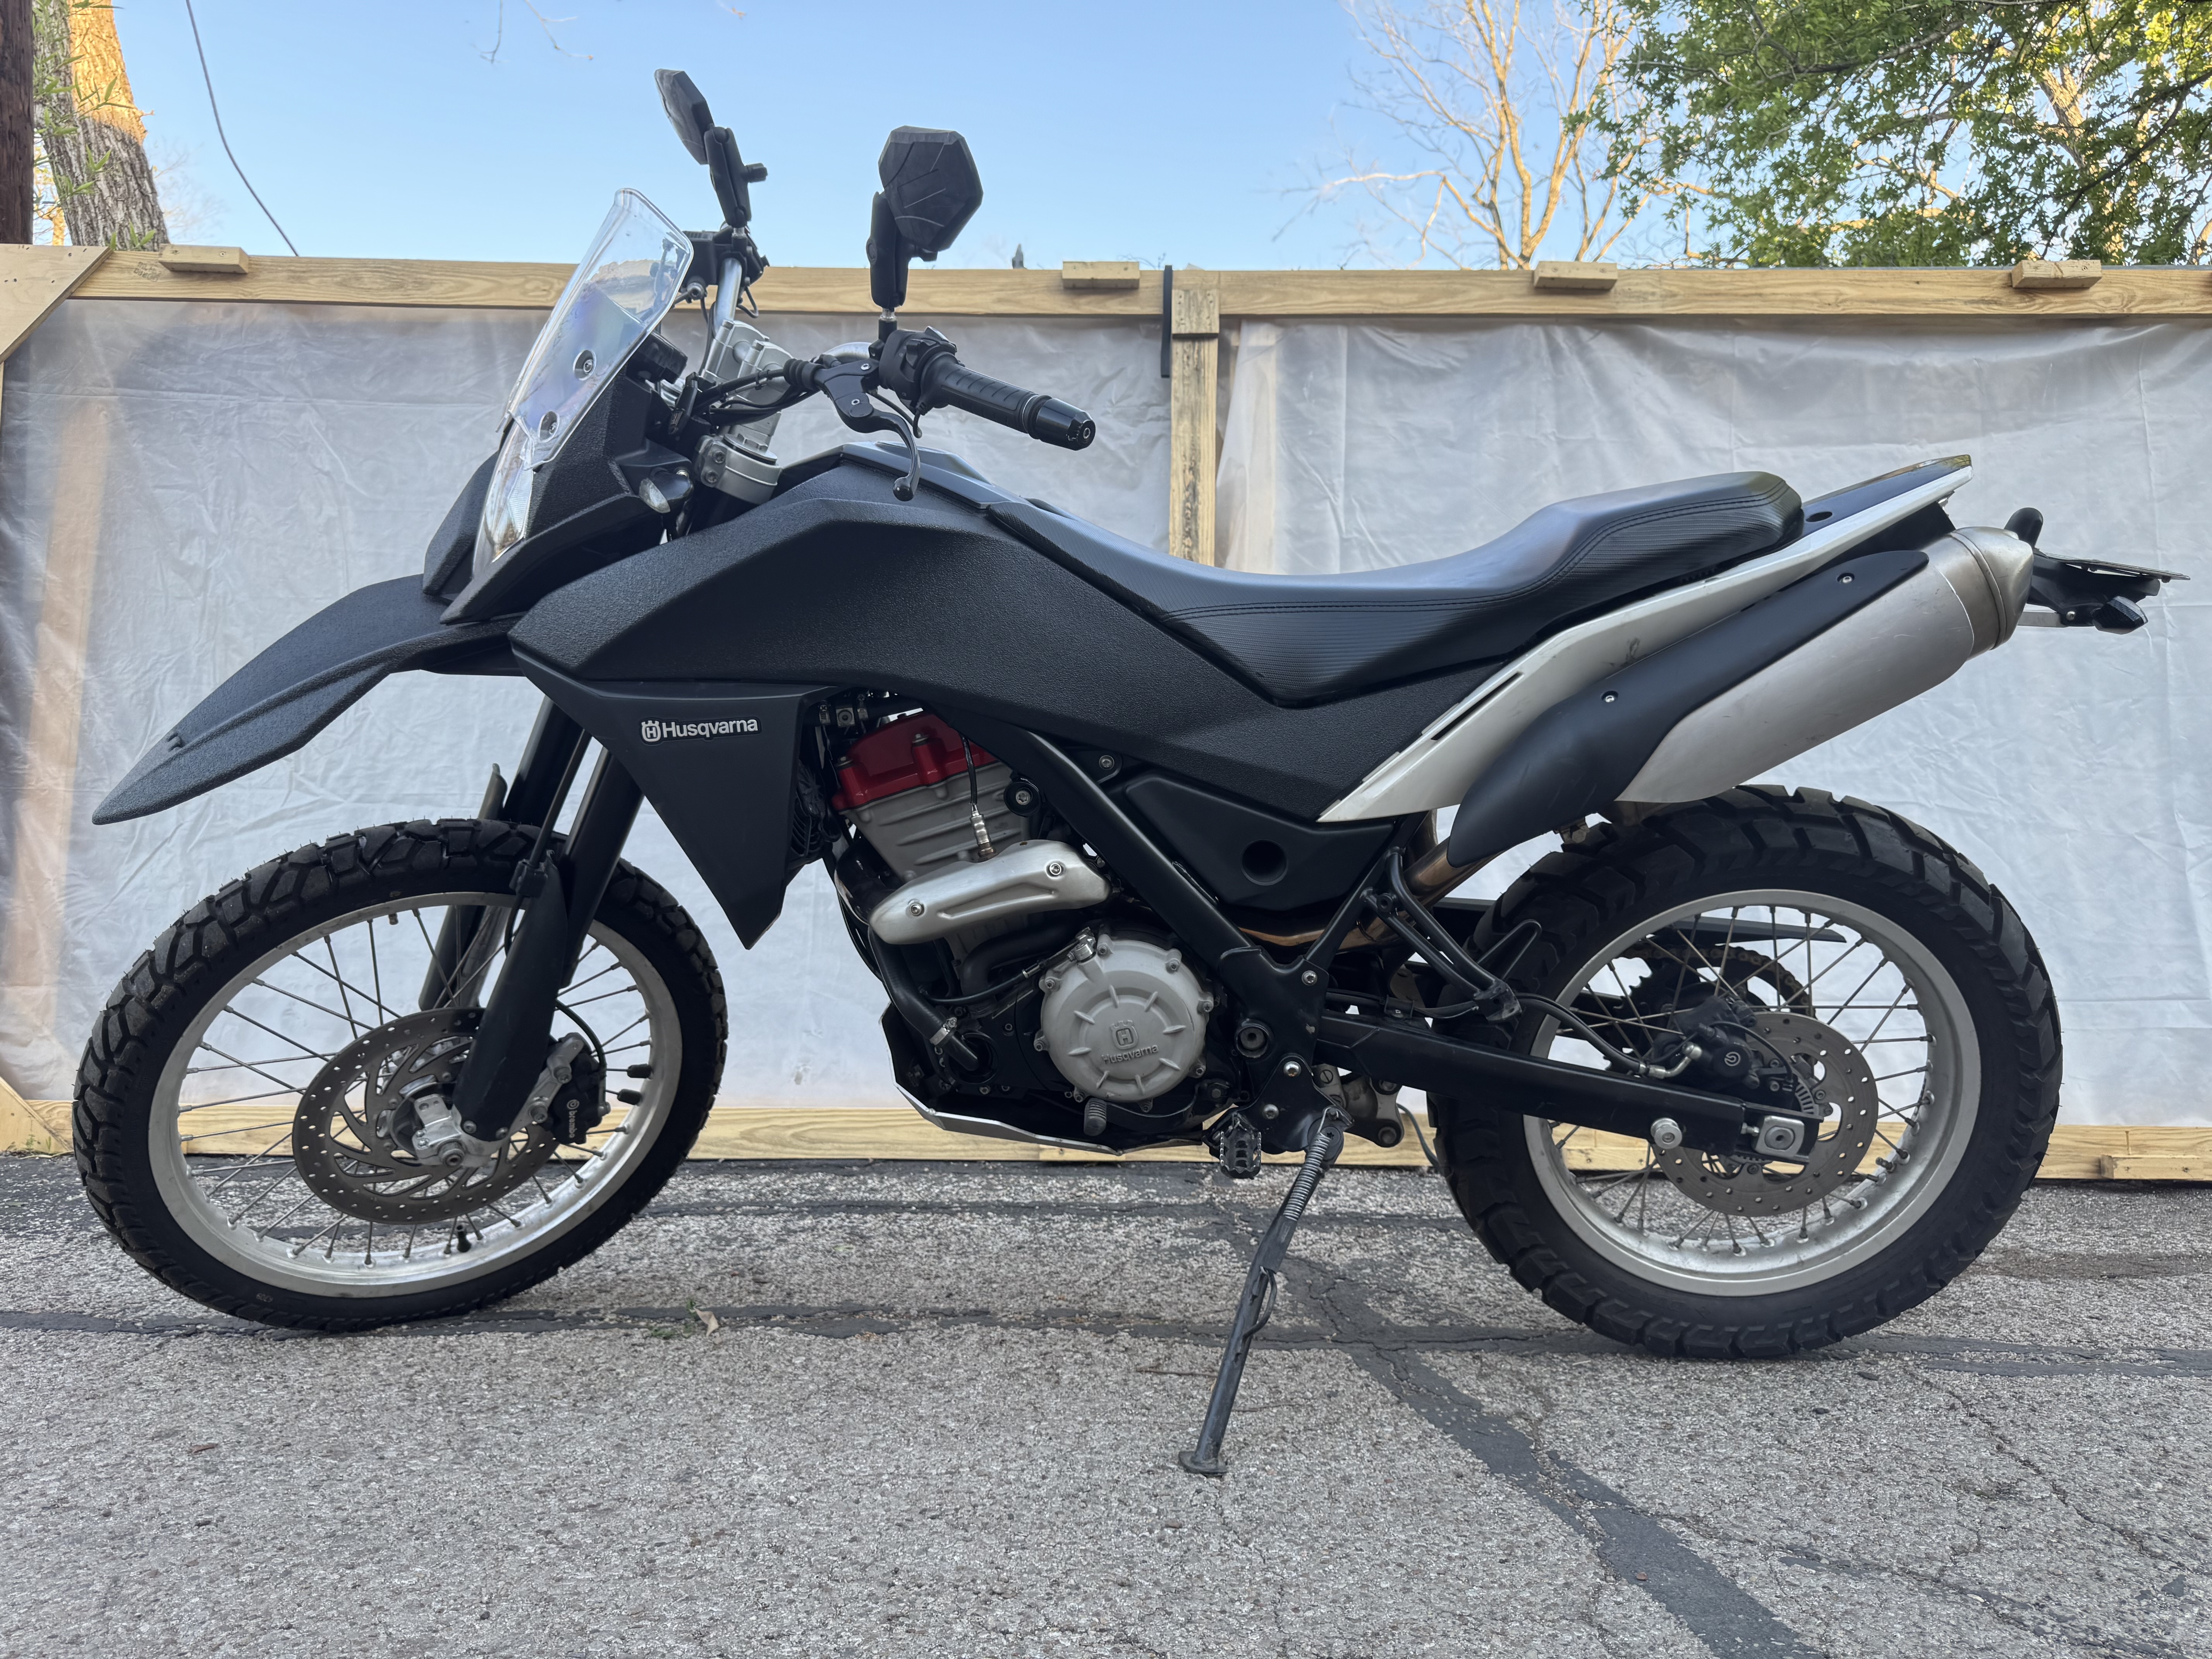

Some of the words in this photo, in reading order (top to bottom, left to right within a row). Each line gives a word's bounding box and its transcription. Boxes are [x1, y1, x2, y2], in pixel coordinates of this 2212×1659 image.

[663, 719, 758, 738] Husqvarna
[1101, 1044, 1159, 1064] Husqvarna
[568, 1110, 577, 1138] brembo
